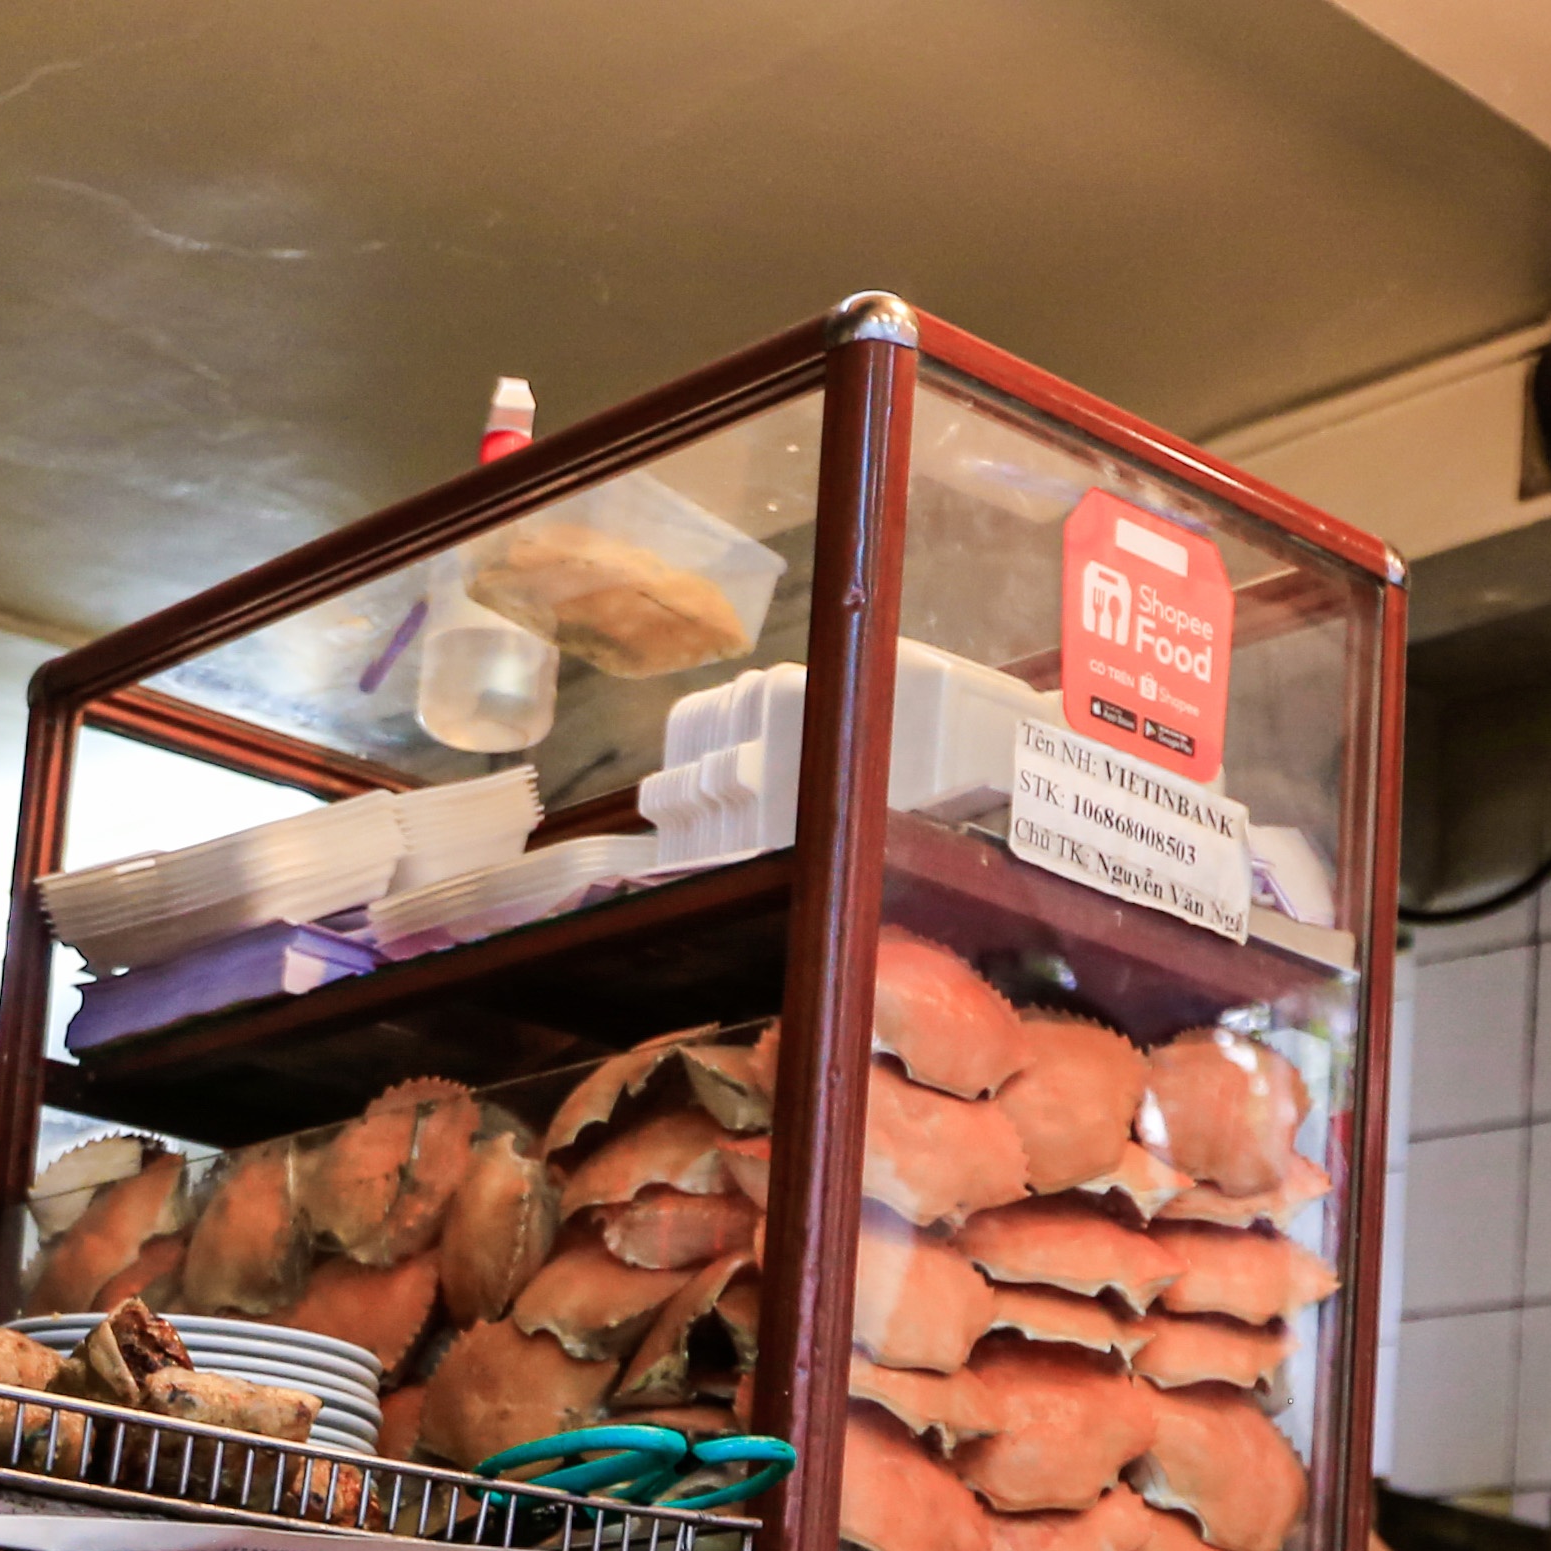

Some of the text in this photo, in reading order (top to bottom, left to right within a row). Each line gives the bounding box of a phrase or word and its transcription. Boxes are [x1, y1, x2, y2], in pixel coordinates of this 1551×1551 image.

[1136, 615, 1212, 683] Food
[1139, 585, 1213, 640] Shopee
[1159, 687, 1199, 717] Shopee
[1020, 769, 1196, 865] STK: 106868008503
[1023, 723, 1234, 838] Tên NH: VIETINBANK
[1016, 818, 1049, 850] Chủ
[1058, 834, 1089, 868] TK:
[1097, 852, 1163, 898] Nguyễn
[1170, 885, 1204, 918] Văn
